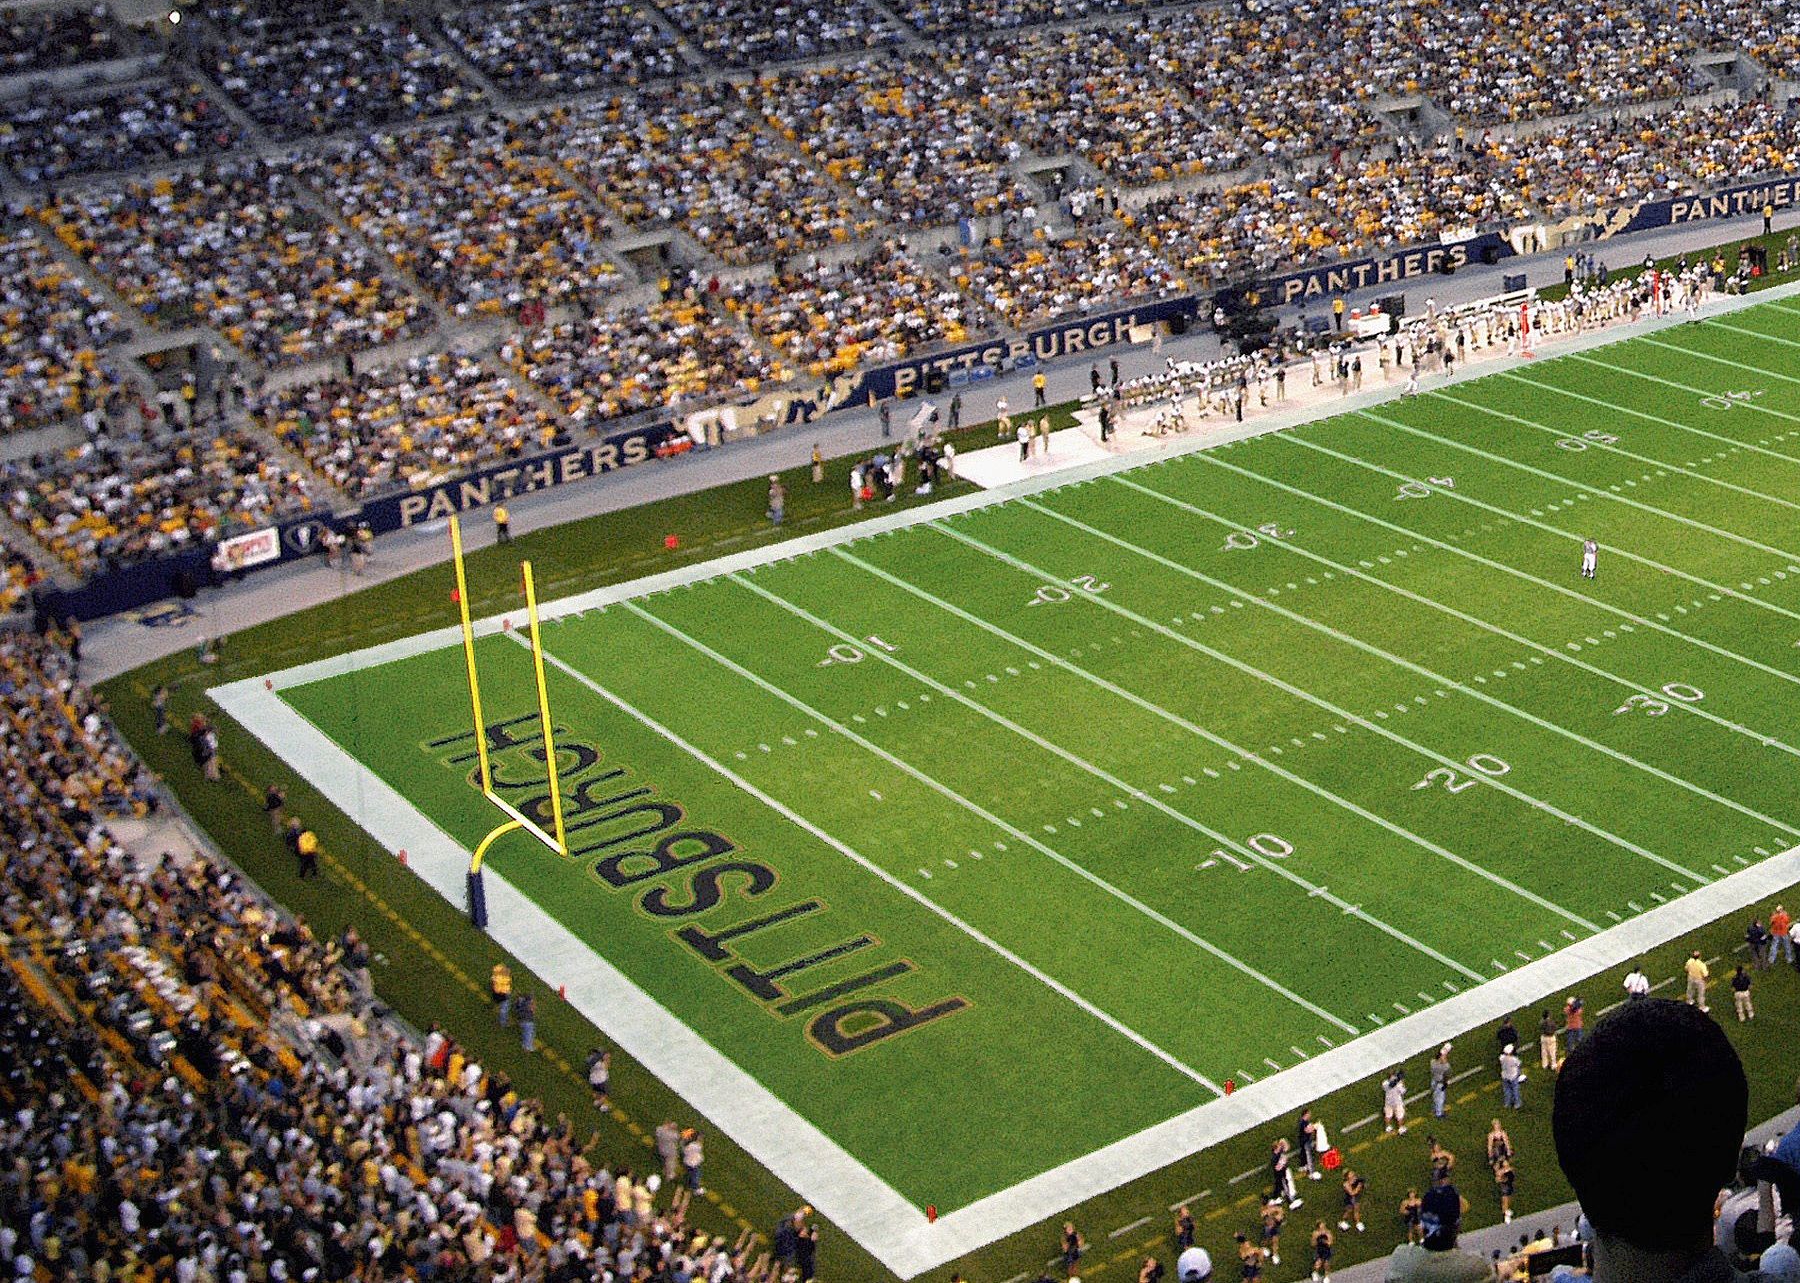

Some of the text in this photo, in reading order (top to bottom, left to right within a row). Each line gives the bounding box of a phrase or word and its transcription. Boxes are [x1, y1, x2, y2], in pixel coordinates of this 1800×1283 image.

[1284, 244, 1467, 304] PANTHERS
[400, 435, 648, 528] PANTHERS
[1626, 682, 1705, 717] 30
[1425, 753, 1513, 794] 20
[1211, 833, 1296, 873] 10
[420, 710, 974, 1060] PITTSBURGH
